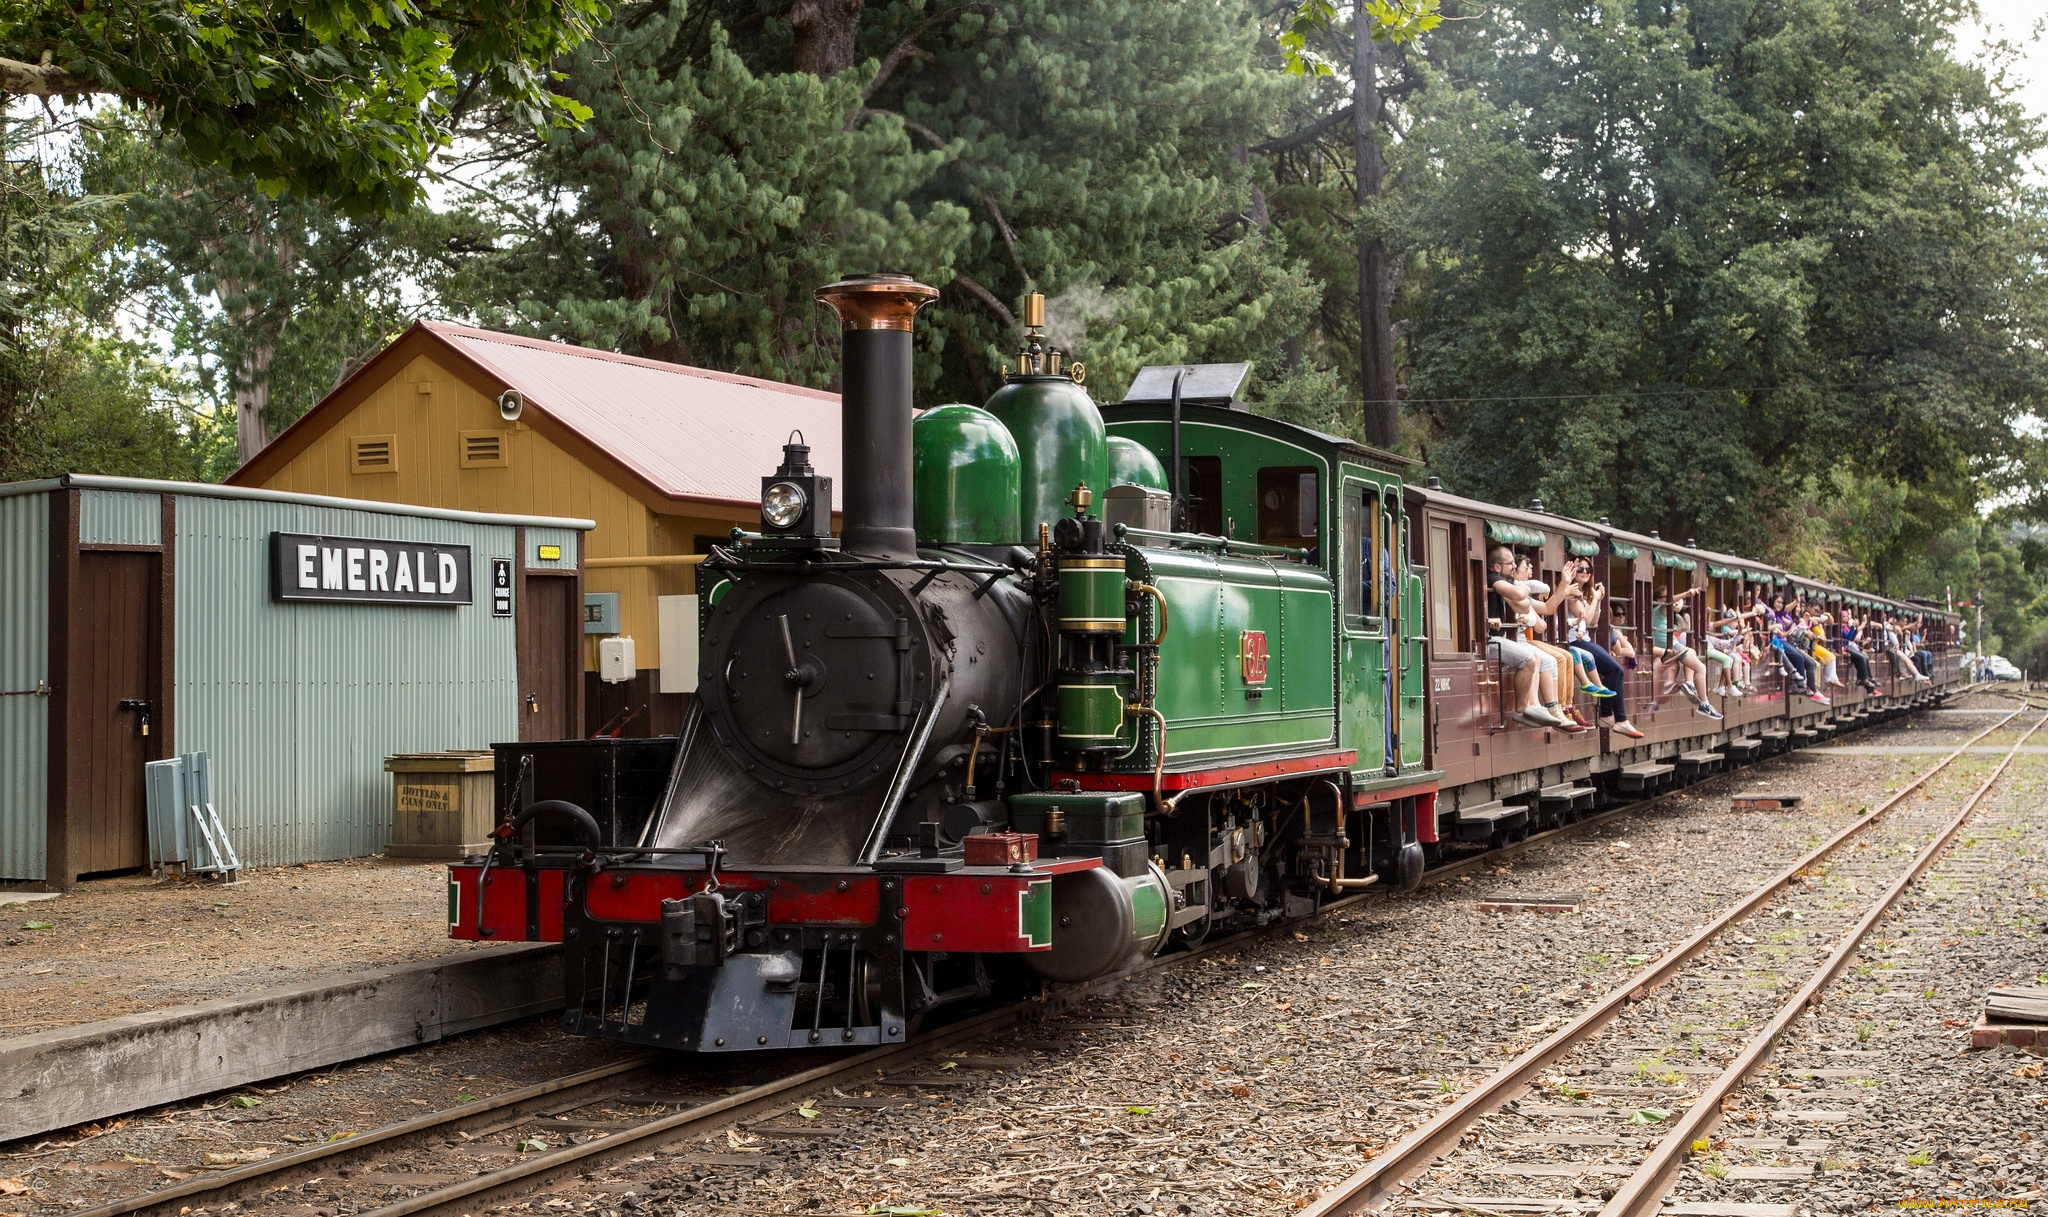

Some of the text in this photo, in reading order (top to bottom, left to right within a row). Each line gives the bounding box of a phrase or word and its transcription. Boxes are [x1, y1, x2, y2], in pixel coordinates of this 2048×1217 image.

[298, 544, 458, 594] EMERALD
[403, 786, 449, 801] BOTTLES &
[401, 797, 448, 811] CANS ONLY
